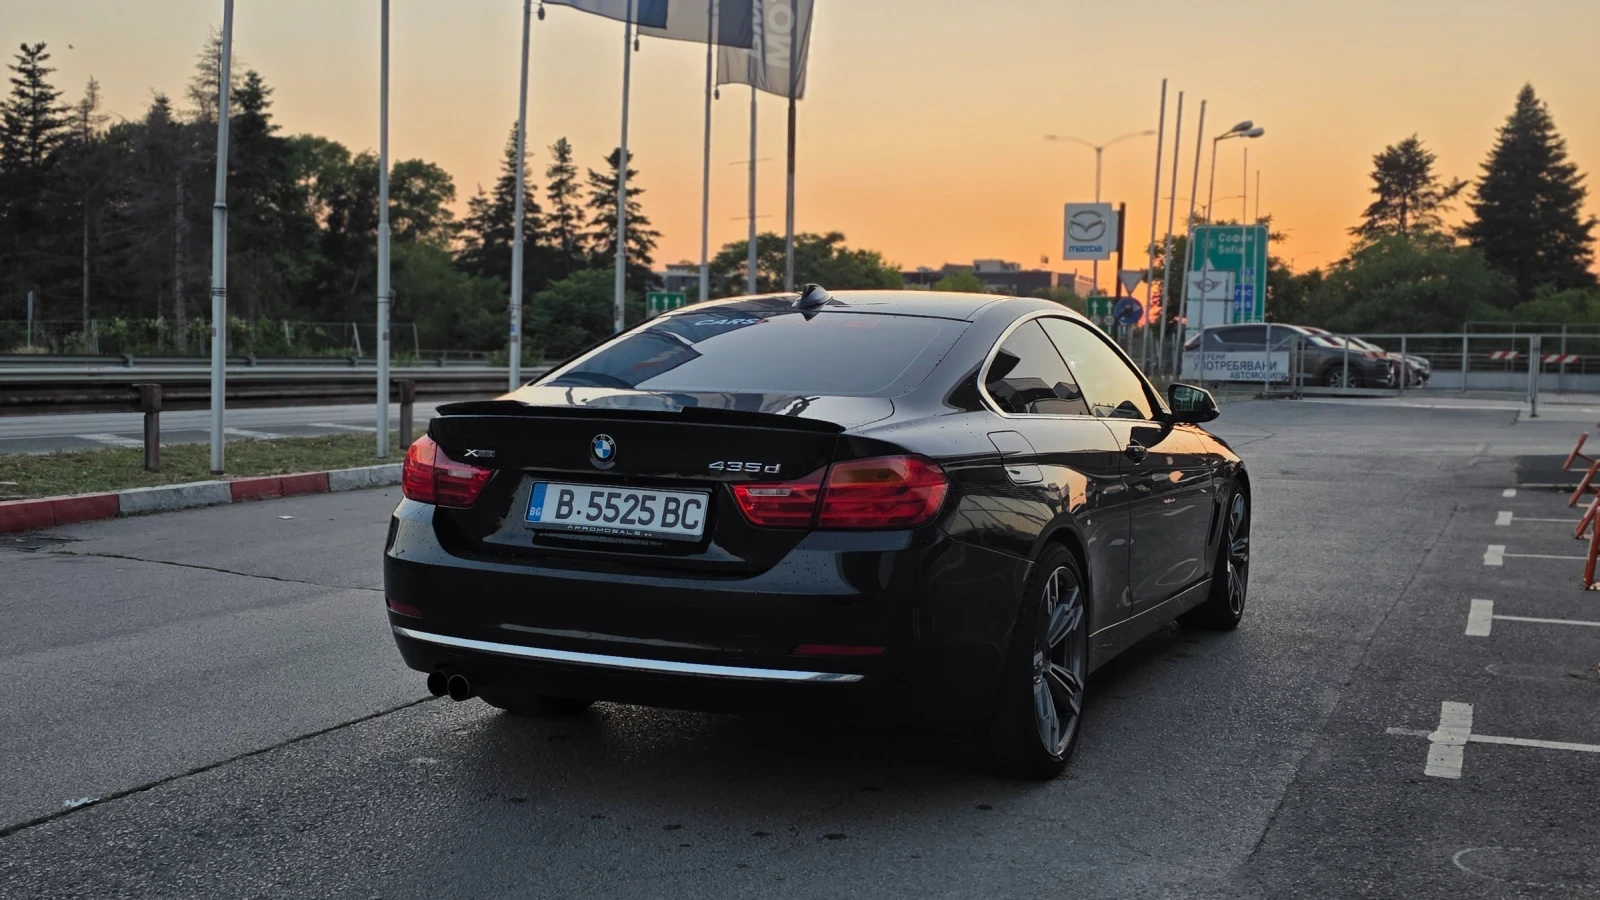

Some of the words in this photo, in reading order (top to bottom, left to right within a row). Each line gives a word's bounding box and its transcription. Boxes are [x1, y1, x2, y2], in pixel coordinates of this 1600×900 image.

[765, 0, 795, 69] MO
[1218, 232, 1253, 243] Софя
[1069, 245, 1103, 253] mazda
[1218, 244, 1245, 254] Sofia
[694, 318, 759, 326] CARS
[1193, 360, 1277, 371] УПОТРЕБЯВАНИ
[708, 460, 782, 474] 435d
[529, 507, 541, 516] BG
